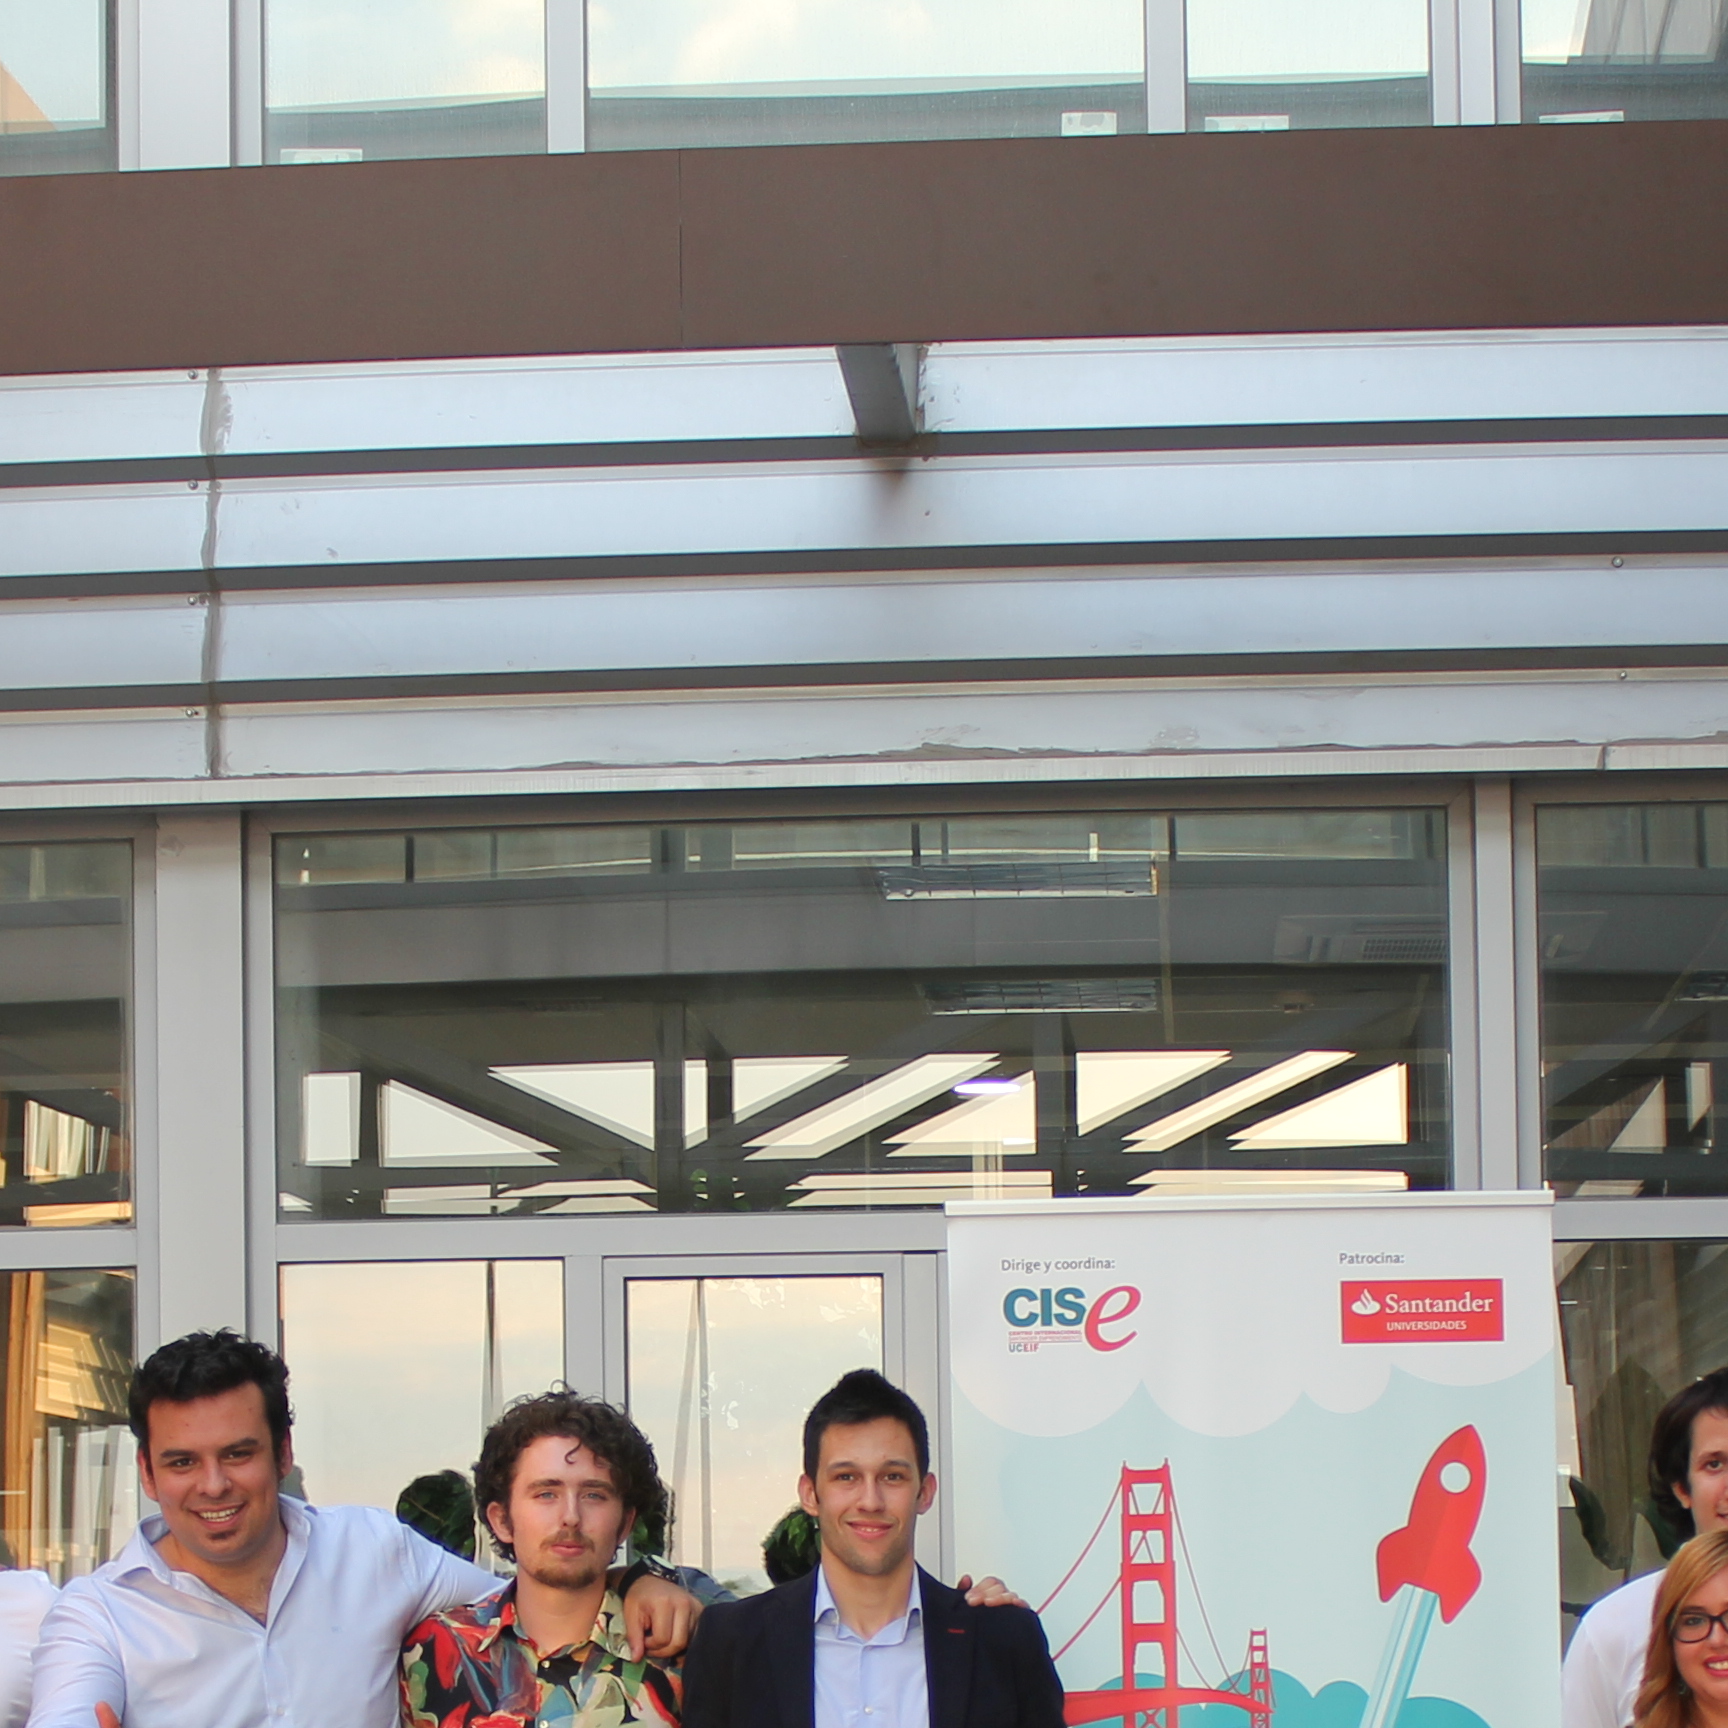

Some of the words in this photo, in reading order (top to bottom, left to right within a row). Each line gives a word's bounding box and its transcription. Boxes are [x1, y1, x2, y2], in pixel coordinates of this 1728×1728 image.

[1339, 1252, 1404, 1264] Patrocina:
[1001, 1259, 1040, 1274] Dirige
[1043, 1261, 1052, 1274] y
[1054, 1257, 1116, 1270] coordina:
[1385, 1291, 1493, 1313] Santander
[1386, 1320, 1467, 1331] UNIVERSIDADES
[1008, 1342, 1040, 1353] UCEIF
